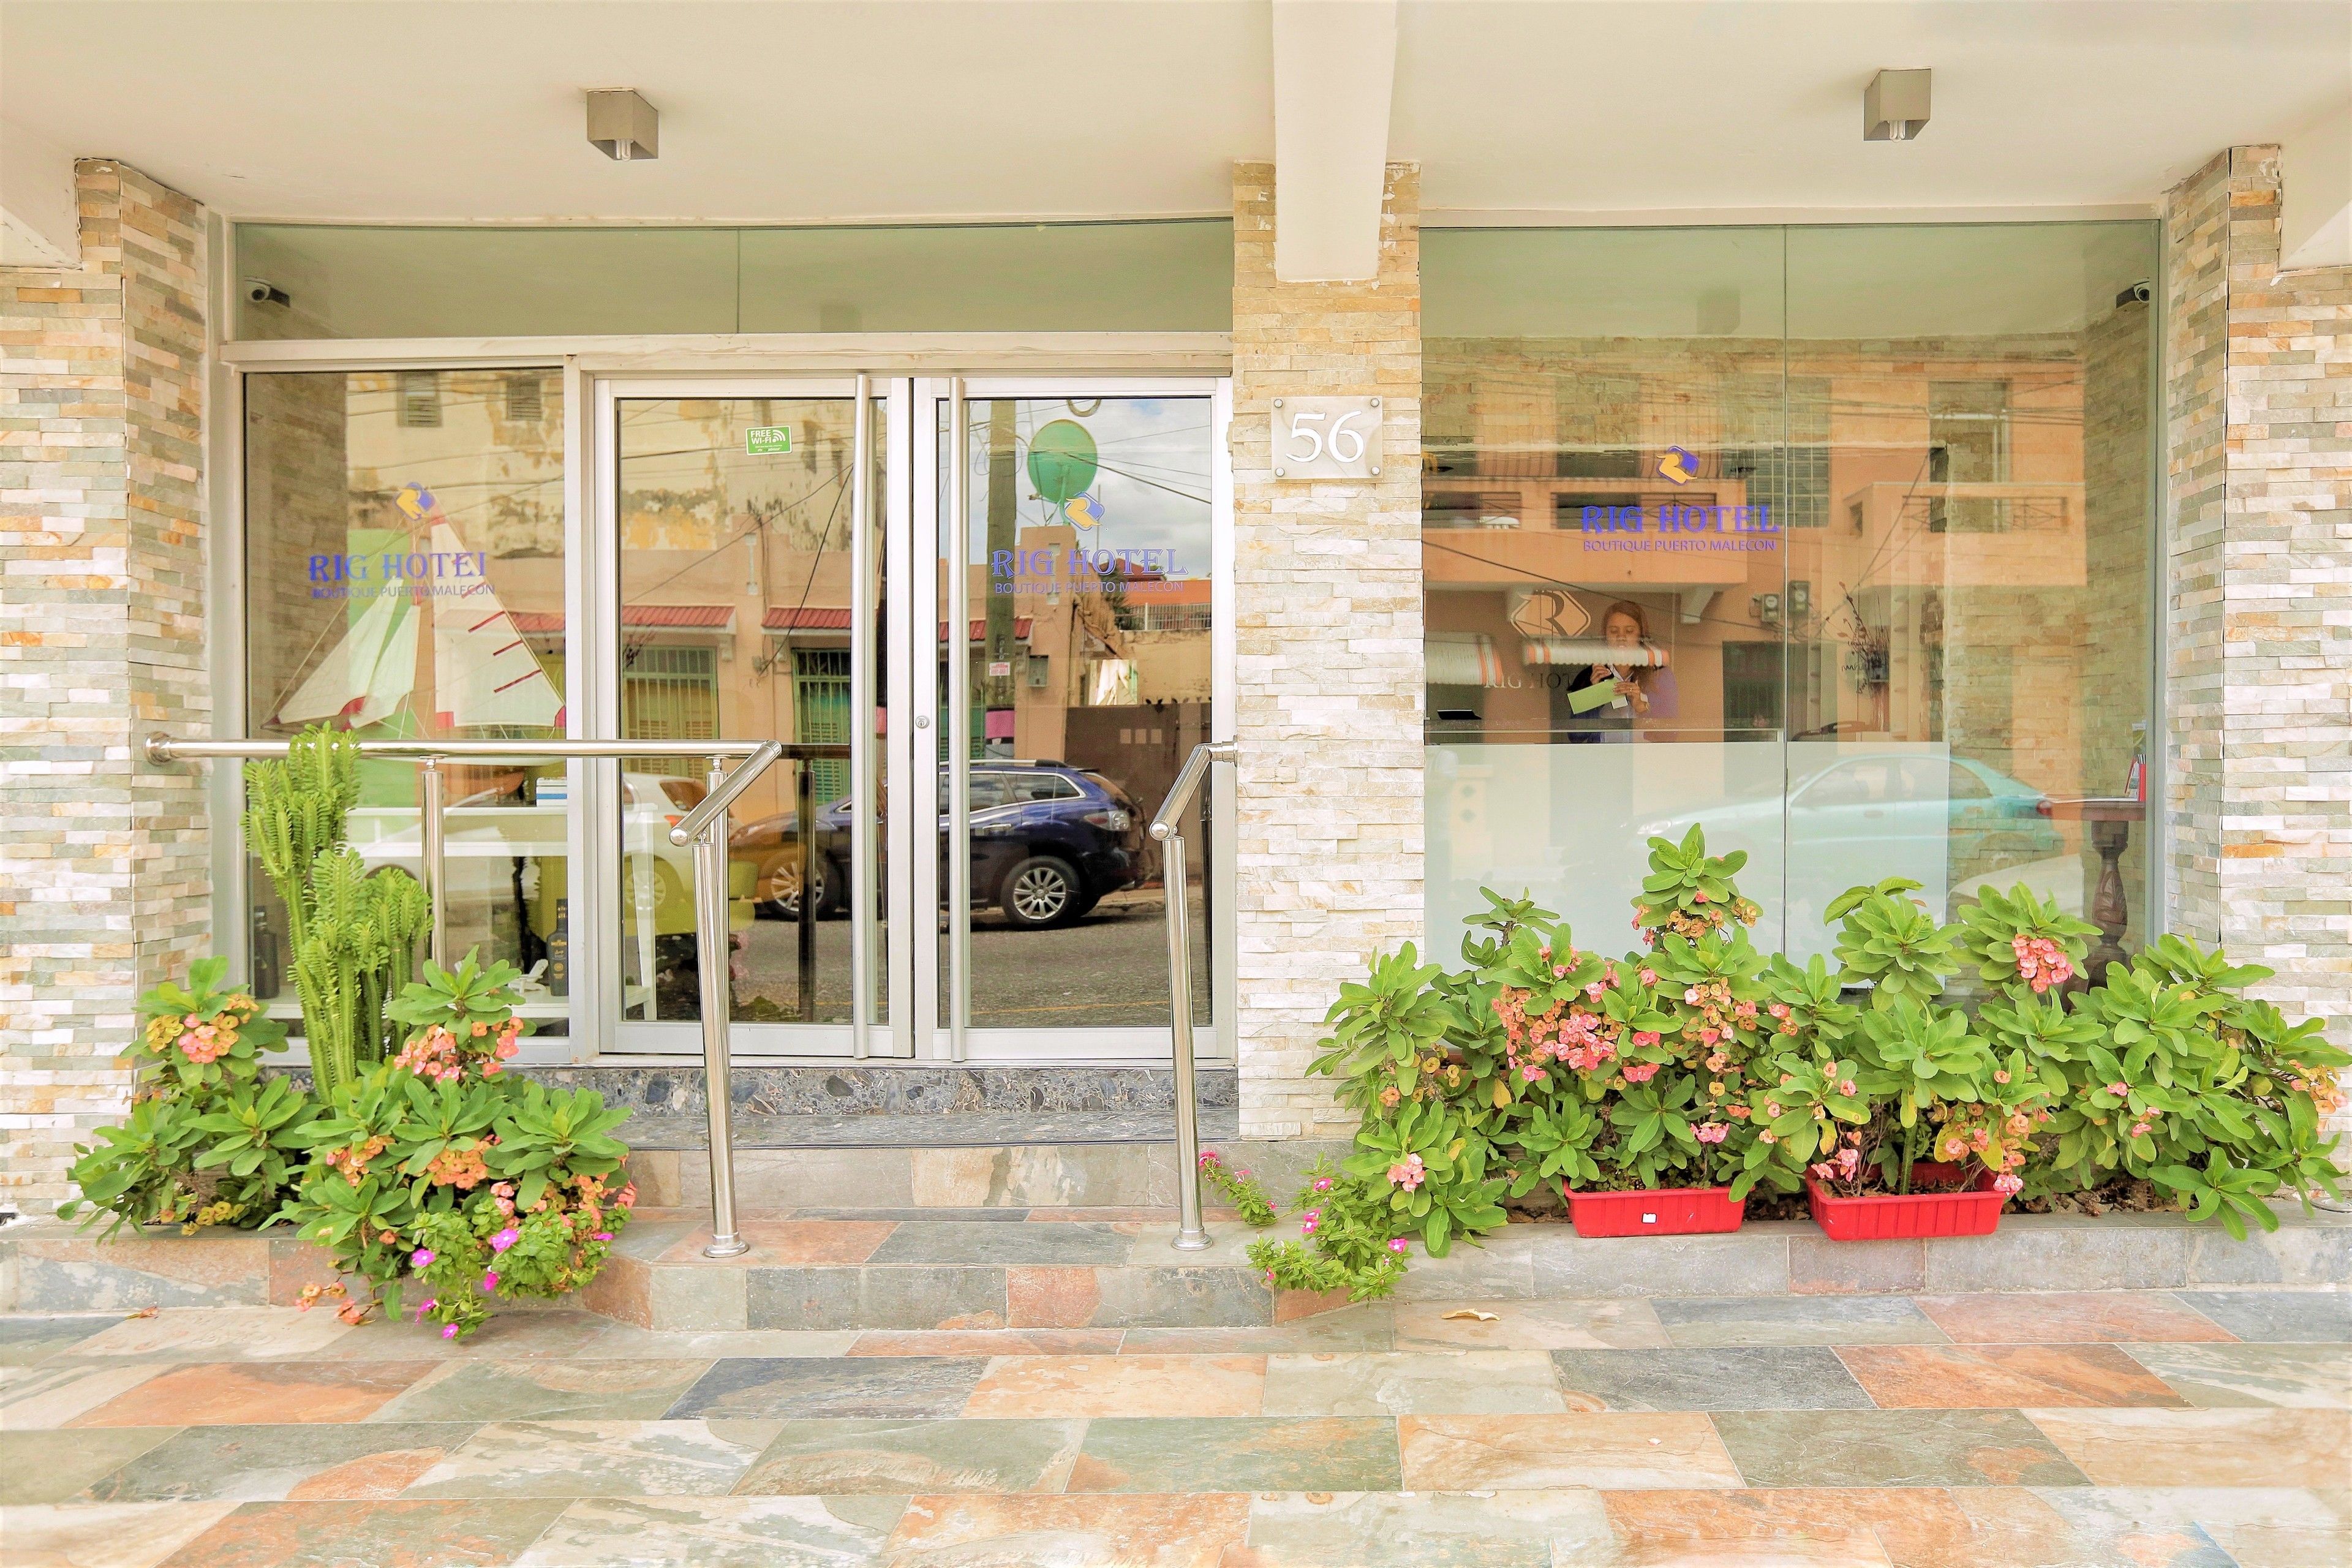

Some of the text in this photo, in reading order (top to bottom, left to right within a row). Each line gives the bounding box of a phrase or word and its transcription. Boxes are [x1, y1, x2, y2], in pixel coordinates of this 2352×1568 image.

[750, 429, 771, 438] FREE
[1286, 410, 1364, 463] 56
[1581, 505, 1779, 534] RIG HOTEL
[1583, 539, 1776, 552] BOUTIQUE PUERTO MALECON
[308, 553, 368, 582] RIG
[991, 548, 1189, 579] RIG HOTEL
[381, 585, 430, 598] PUERTO
[995, 581, 1184, 594] BOUTIQUE PUERTO MALECON
